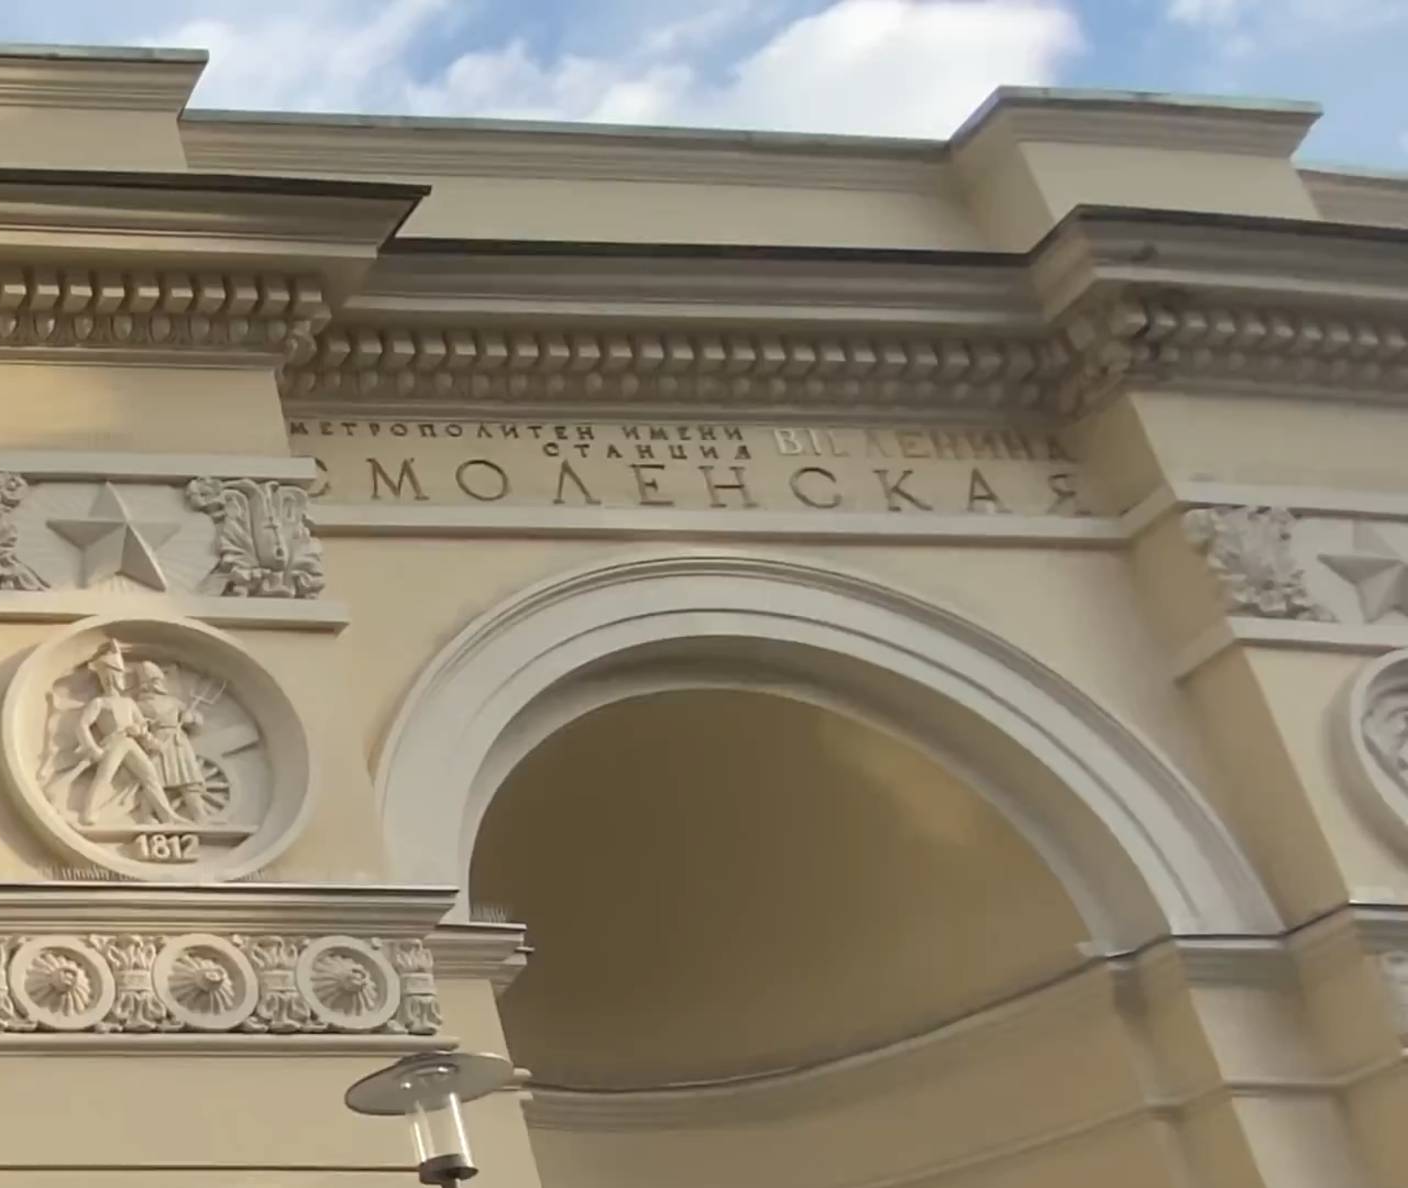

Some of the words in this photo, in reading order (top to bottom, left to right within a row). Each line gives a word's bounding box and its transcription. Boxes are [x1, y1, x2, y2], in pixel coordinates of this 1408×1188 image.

[289, 420, 595, 442] МЕТРОПОЛИТЕН
[621, 425, 744, 442] ИМЕНИ
[542, 441, 752, 461] СТАНЦИЯ
[135, 833, 201, 860] 1812
